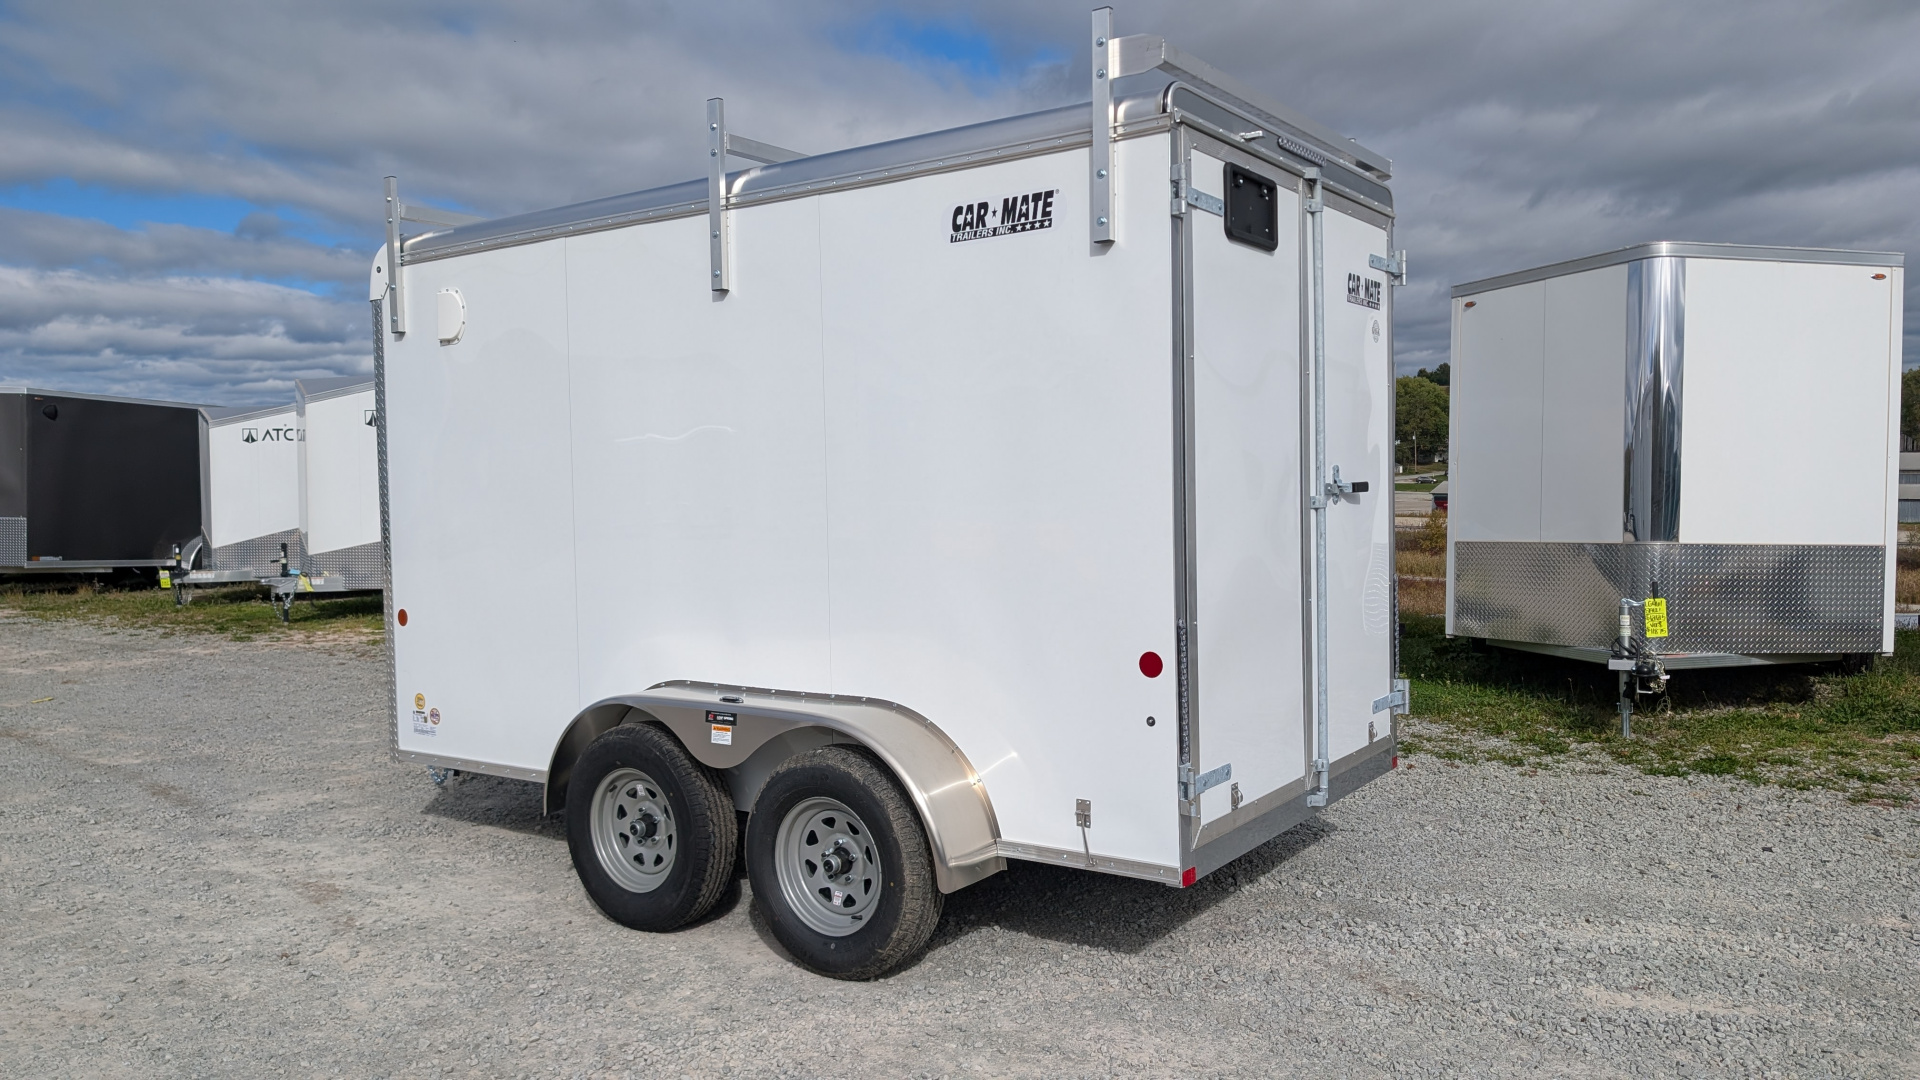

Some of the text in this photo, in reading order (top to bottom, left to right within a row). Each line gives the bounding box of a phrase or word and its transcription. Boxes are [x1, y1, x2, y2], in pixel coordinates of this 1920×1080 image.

[952, 190, 1055, 232] CAR MATE
[952, 225, 1014, 242] TRAILERS INC.
[1348, 272, 1382, 303] CAR MATE
[261, 428, 294, 442] ATC
